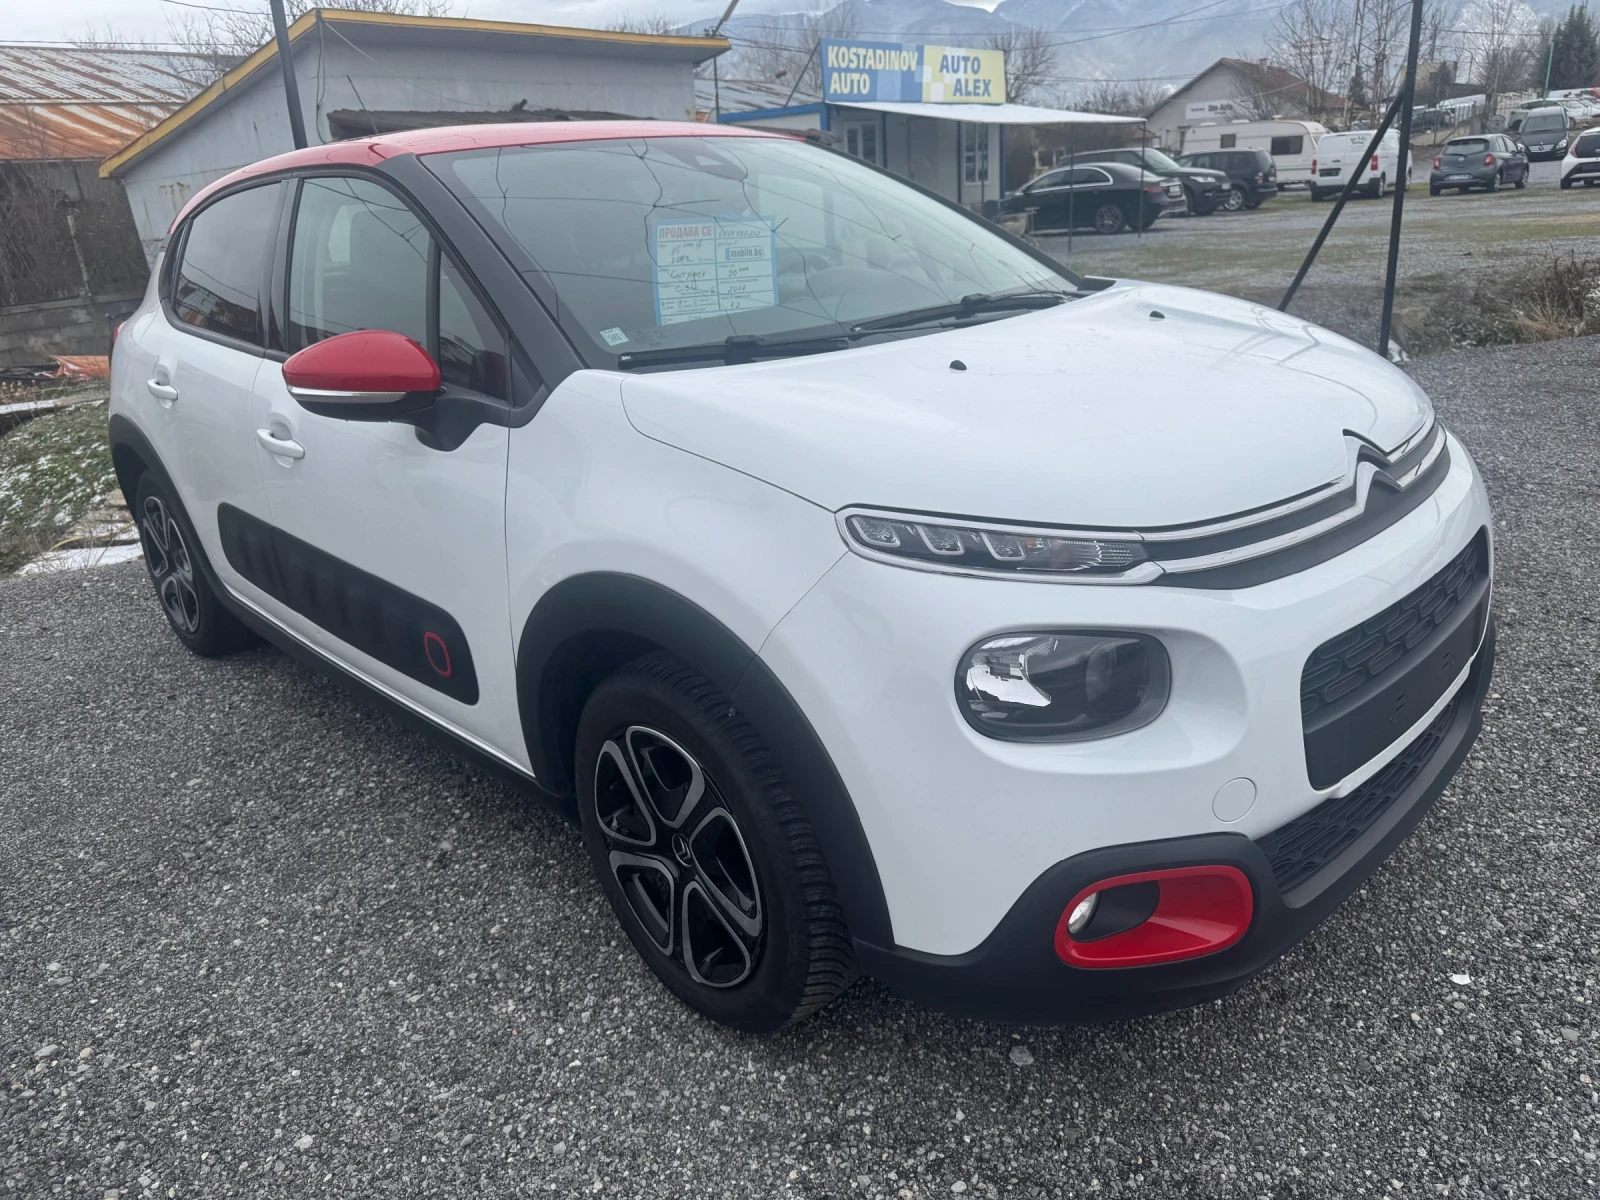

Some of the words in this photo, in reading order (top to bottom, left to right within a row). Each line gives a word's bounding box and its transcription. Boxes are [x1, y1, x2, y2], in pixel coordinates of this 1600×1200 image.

[828, 46, 918, 71] KOSTADINOV
[939, 55, 981, 75] AUTO
[829, 72, 870, 94] AUTO
[953, 78, 992, 97] ALEX
[659, 226, 699, 239] ПРОДАВА
[701, 225, 712, 237] СЕ
[730, 247, 763, 258] mobile.bg
